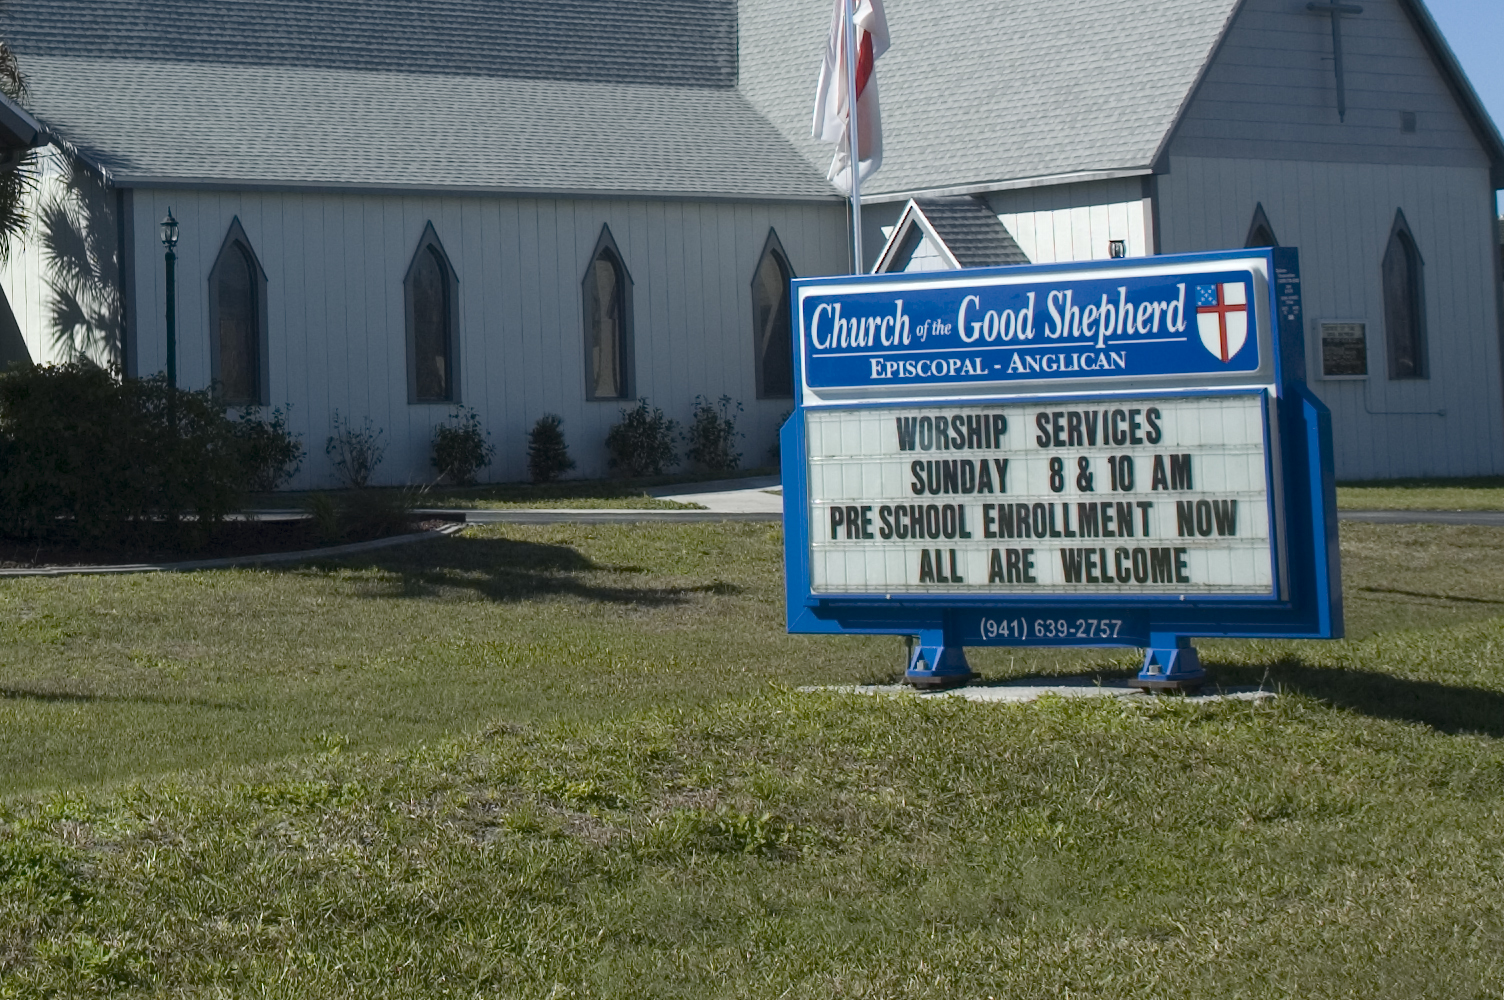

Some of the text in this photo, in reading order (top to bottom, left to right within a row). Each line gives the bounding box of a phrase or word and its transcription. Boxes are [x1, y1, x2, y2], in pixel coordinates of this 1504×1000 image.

[810, 282, 1188, 351] Church of the Good Shepherd
[896, 405, 1163, 452] WORSHIP SERVICES
[910, 453, 1194, 496] SUNDAY 8 & 10 AM
[982, 500, 1154, 539] ENROLLMENT
[1176, 499, 1238, 538] NOW
[919, 546, 1190, 584] ALL ARE WELCOME
[980, 617, 1122, 641] (941) 639-2757
